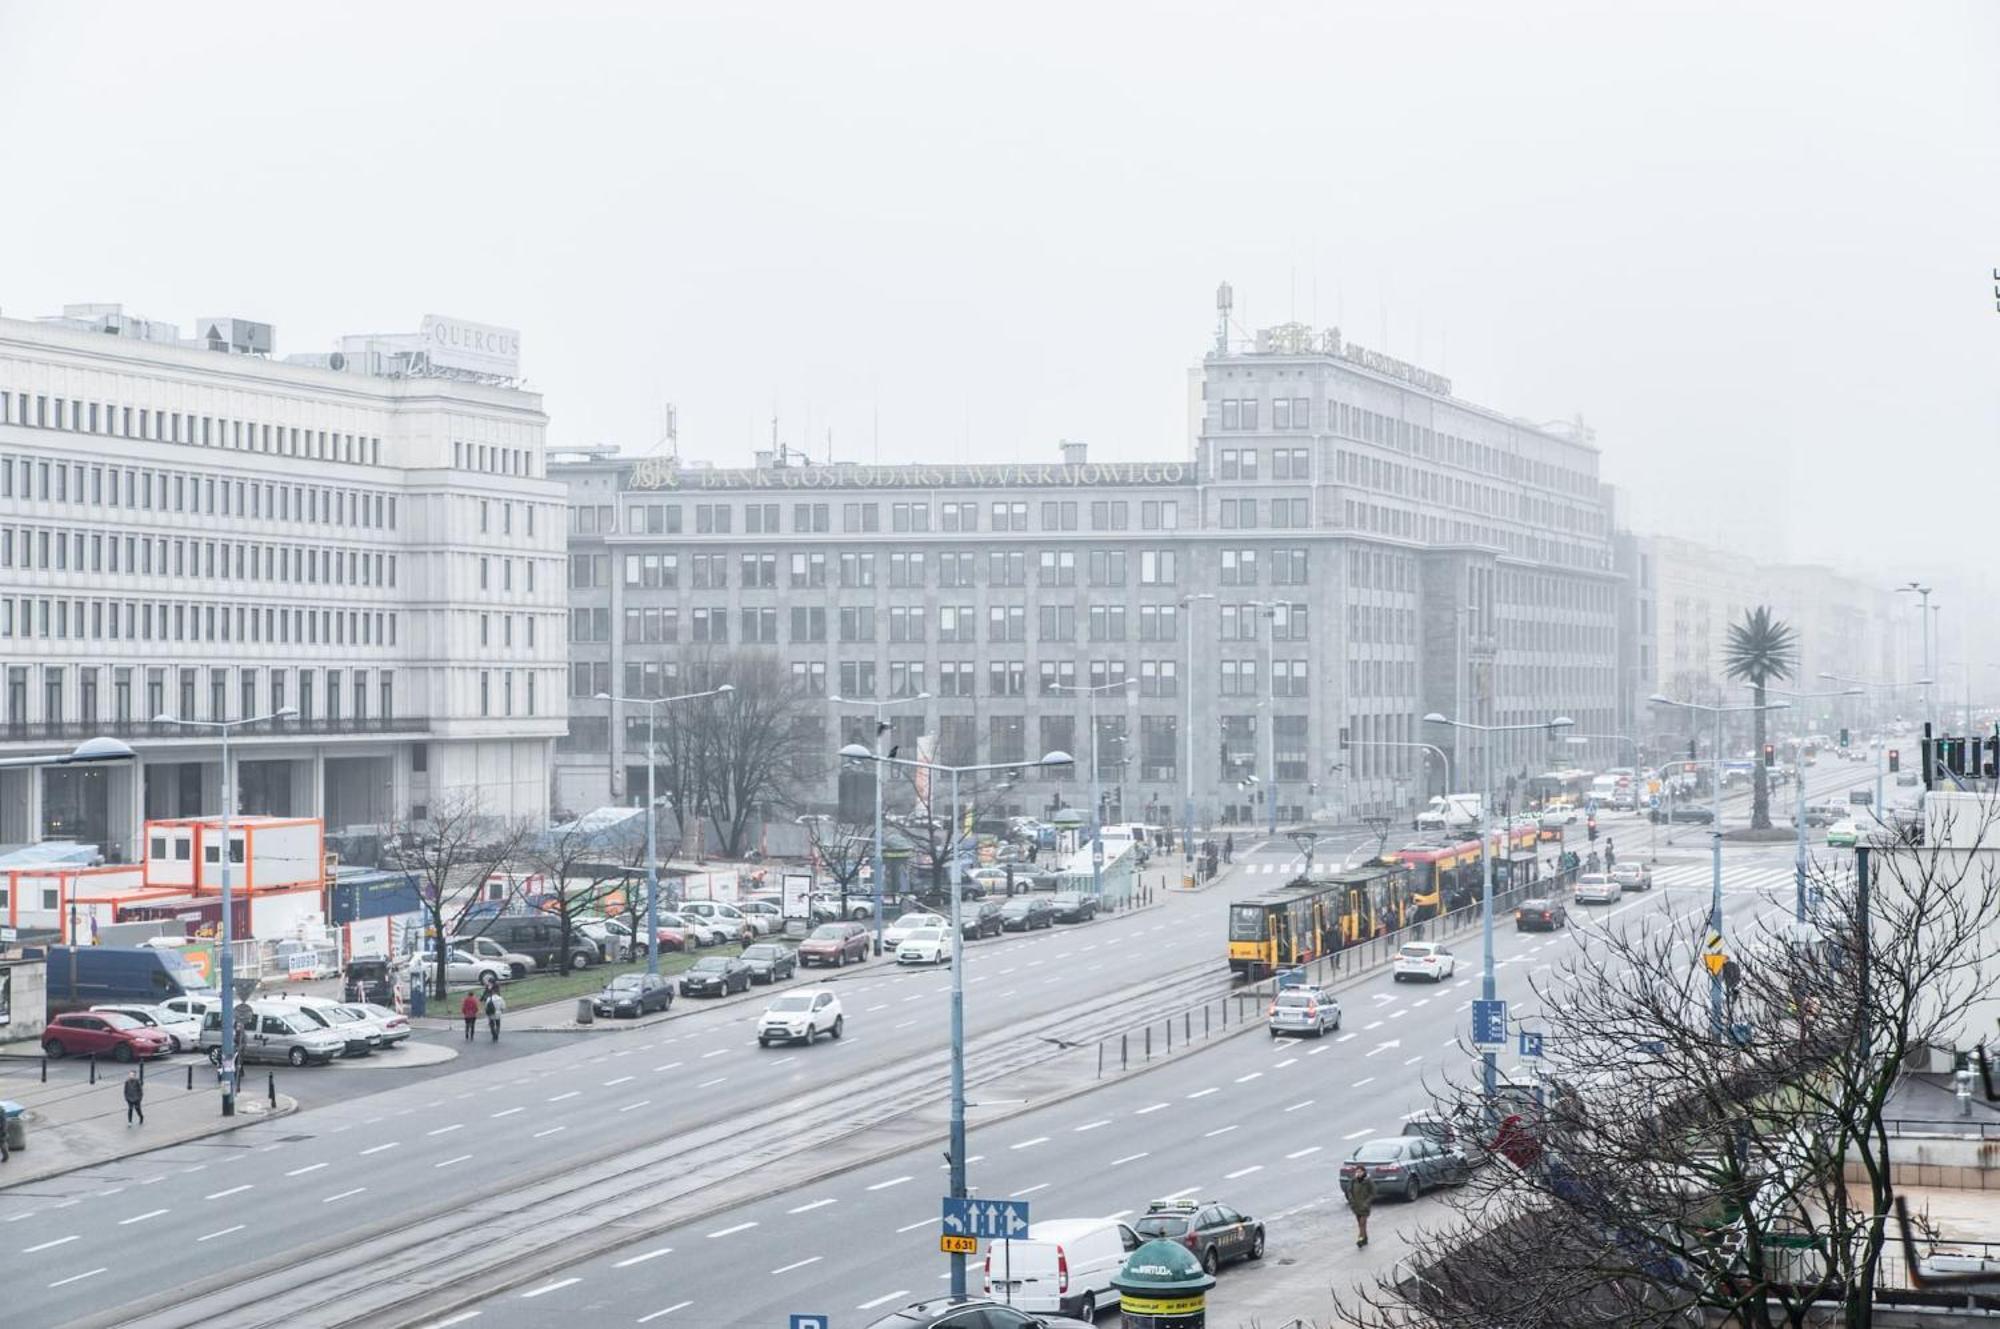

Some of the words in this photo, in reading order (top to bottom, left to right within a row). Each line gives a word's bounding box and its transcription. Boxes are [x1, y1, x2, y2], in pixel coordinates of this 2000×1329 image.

[436, 323, 519, 354] QUERCUS
[701, 467, 772, 488] BANK
[782, 465, 1006, 488] GOSPODARSTWA
[1016, 463, 1183, 487] KRAJOWEGO
[954, 1239, 973, 1250] 631
